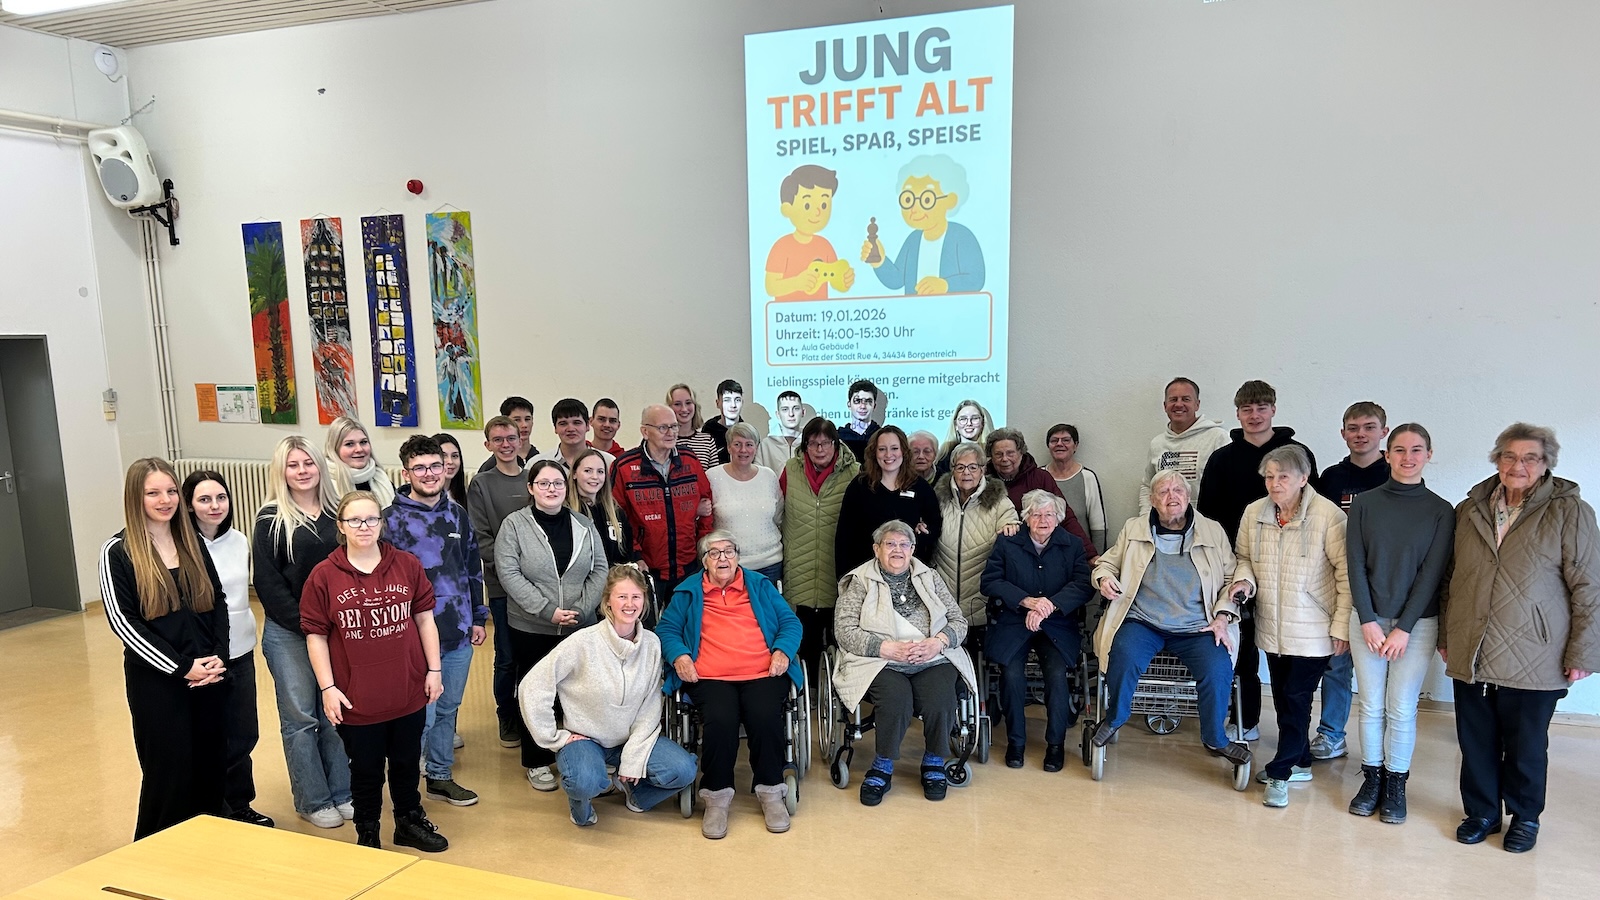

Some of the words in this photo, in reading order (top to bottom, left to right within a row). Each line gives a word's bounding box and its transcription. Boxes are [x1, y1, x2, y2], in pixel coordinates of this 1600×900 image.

[799, 27, 952, 85] JUNG
[767, 84, 902, 129] TRIFFT
[915, 76, 993, 118] ALT
[776, 136, 837, 157] SPIEL,
[843, 130, 902, 152] SPAß,
[908, 123, 981, 146] SPEISE
[775, 312, 817, 323] Datum:
[821, 308, 887, 322] 19.01.2026
[775, 328, 821, 340] Uhrzeit:
[823, 326, 890, 340] 14:00-15:30
[893, 326, 915, 338] Uhr
[776, 346, 798, 357] Ort:
[801, 343, 818, 351] Aula
[819, 342, 854, 351] Gebäude
[855, 342, 859, 350] 1
[801, 354, 820, 362] Platz
[820, 353, 834, 361] der
[835, 353, 856, 361] Stadt
[857, 352, 871, 360] Rue
[873, 352, 881, 360] 4,
[882, 351, 906, 359] 34434
[907, 349, 957, 360] Borgentreich
[767, 375, 845, 389] Lieblingsspiele
[892, 375, 925, 388] gerne
[928, 372, 1000, 387] mitgebracht
[815, 408, 841, 419] chen
[885, 407, 919, 418] ränke
[921, 407, 935, 418] ist
[634, 488, 663, 501] BLUE
[671, 483, 697, 497] WAVE
